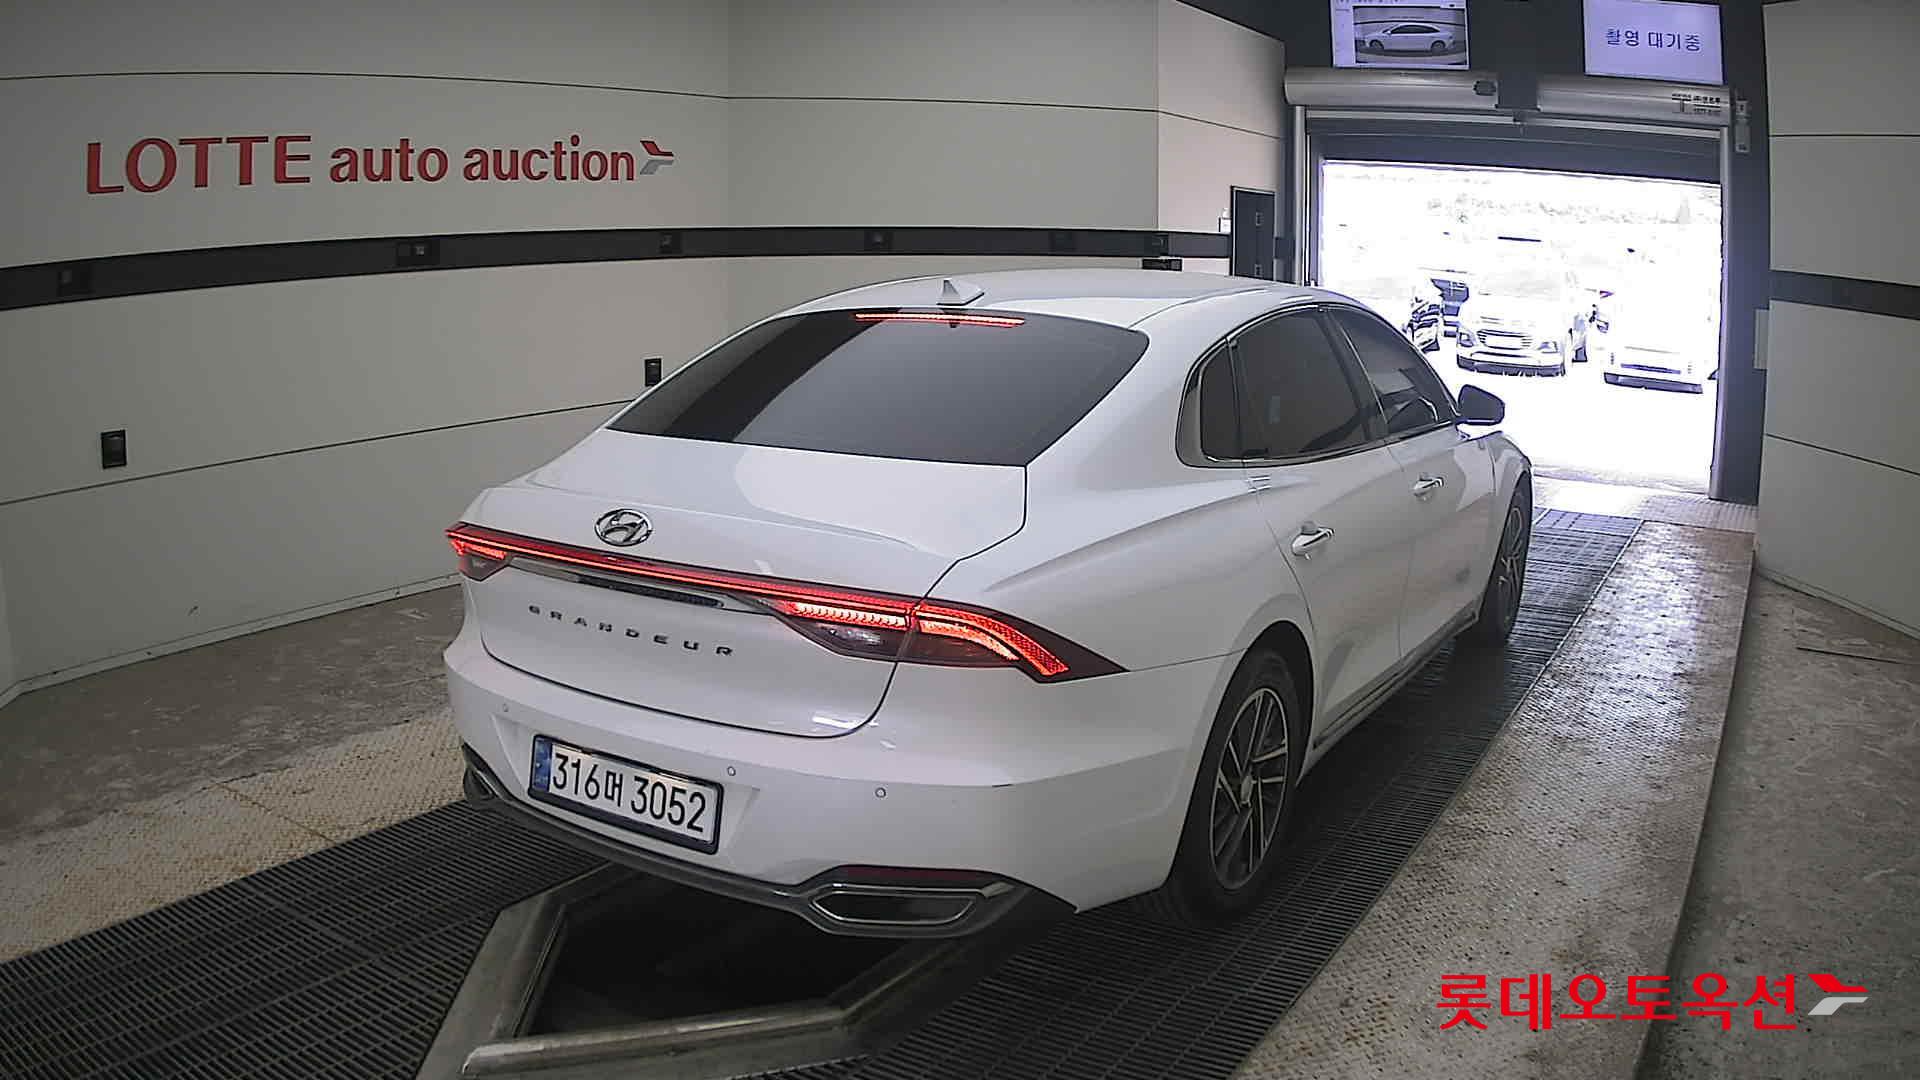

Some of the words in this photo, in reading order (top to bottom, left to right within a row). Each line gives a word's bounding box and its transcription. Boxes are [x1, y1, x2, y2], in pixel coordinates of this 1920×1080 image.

[1647, 31, 1700, 52] 대기중
[86, 134, 312, 194] LOTTE
[329, 137, 449, 183] auto
[463, 134, 636, 182] auction
[528, 604, 734, 656] GRANDEUR
[552, 752, 624, 808] 316머
[631, 775, 706, 833] 3052
